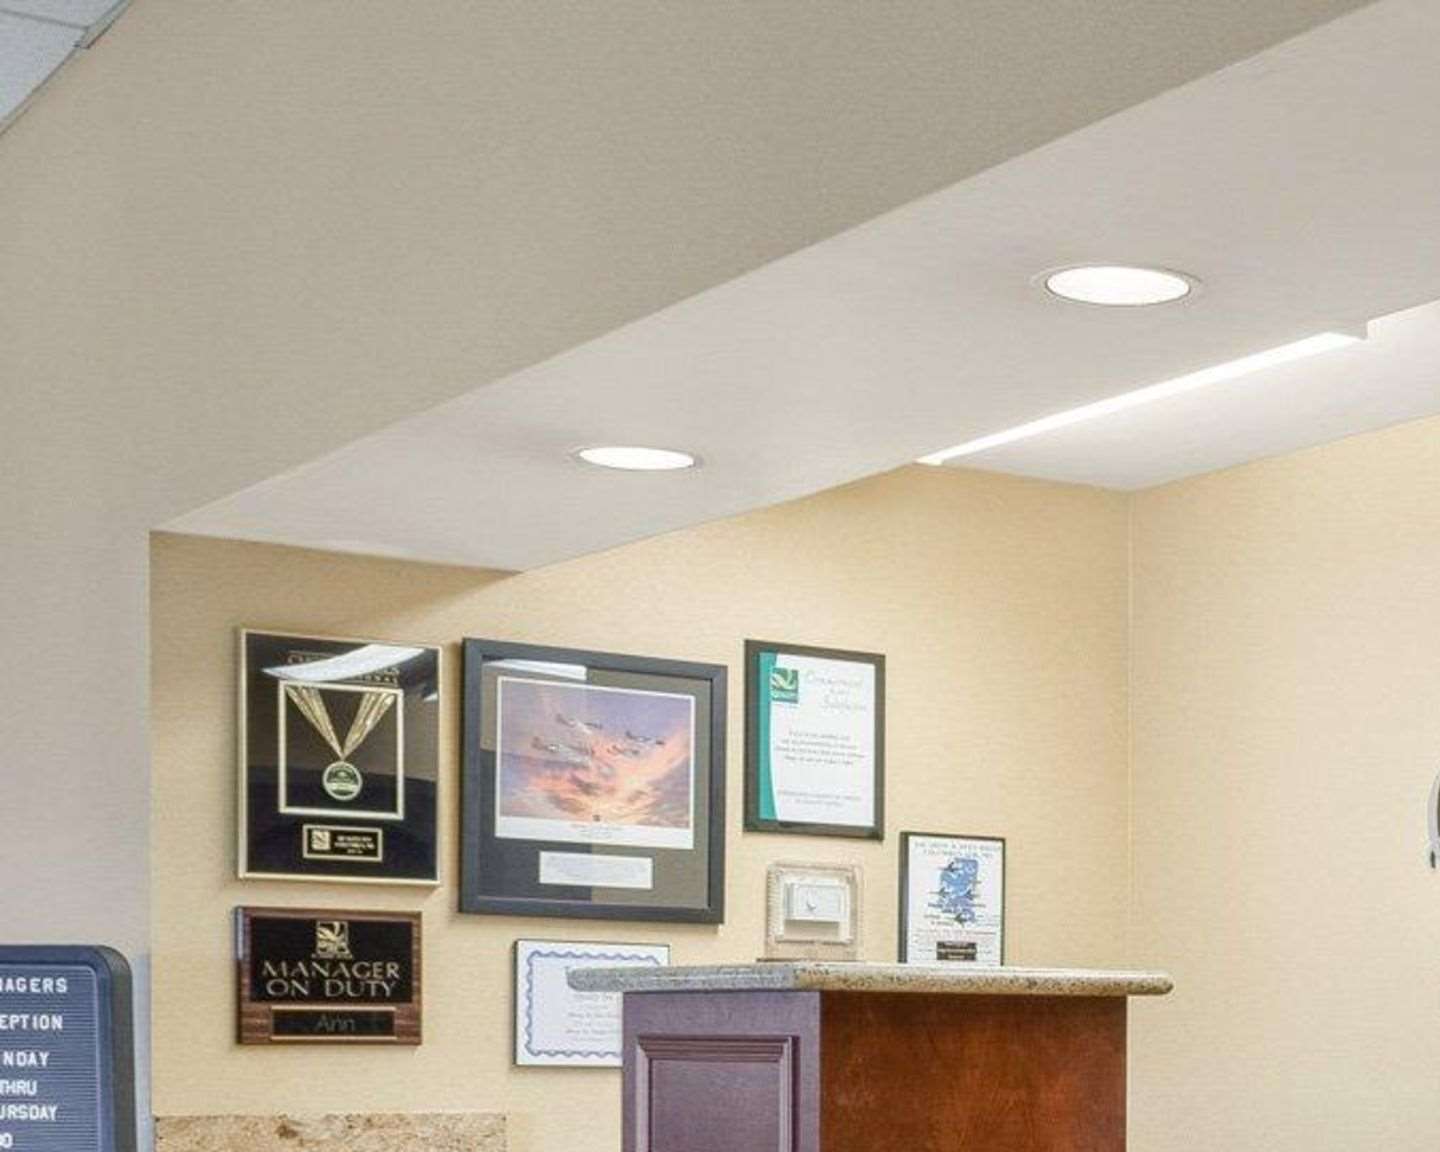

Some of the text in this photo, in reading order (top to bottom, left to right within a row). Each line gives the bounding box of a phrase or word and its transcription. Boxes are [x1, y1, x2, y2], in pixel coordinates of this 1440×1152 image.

[262, 961, 400, 979] MANAGER
[266, 978, 396, 997] ON DUTY
[3, 1051, 49, 1067] NDAY
